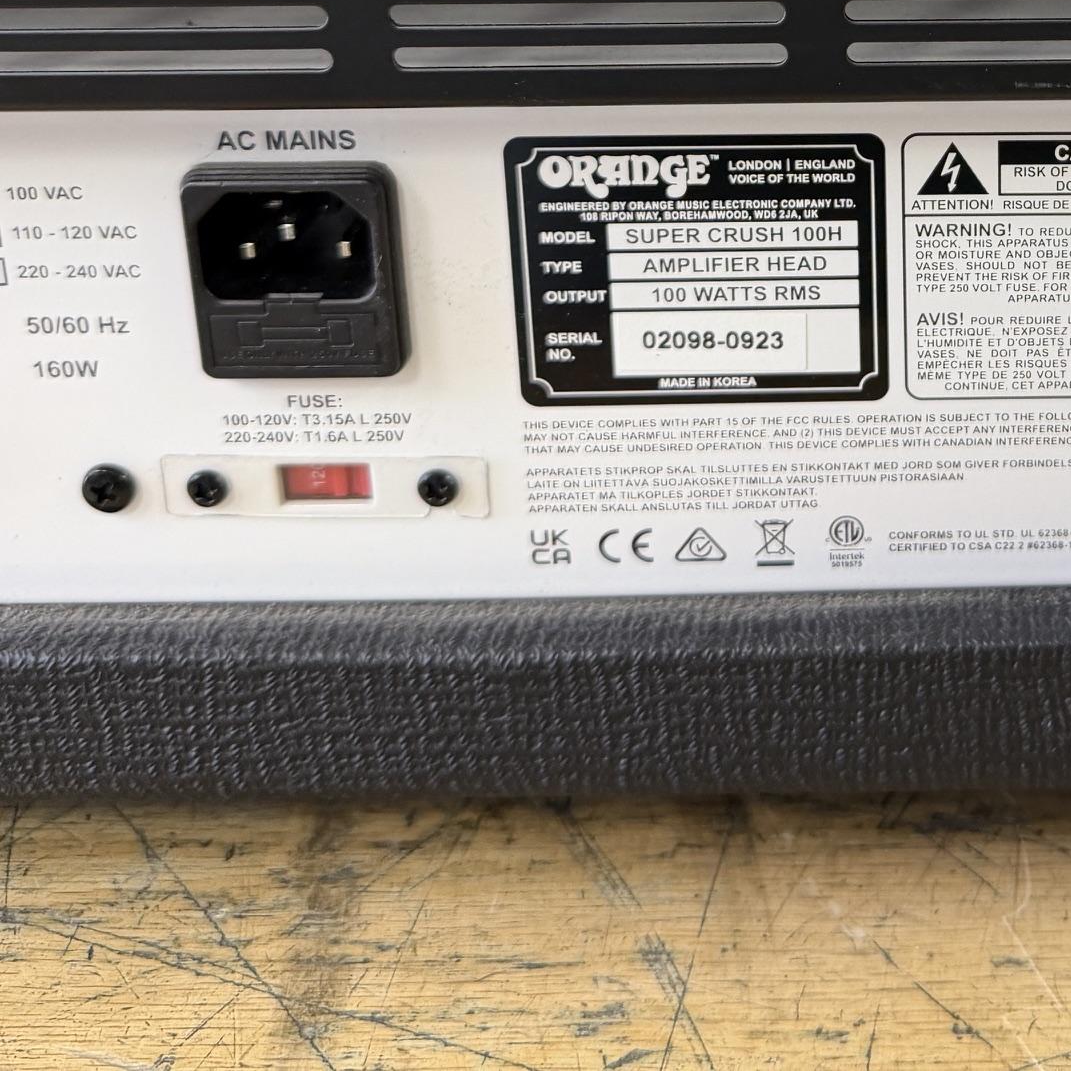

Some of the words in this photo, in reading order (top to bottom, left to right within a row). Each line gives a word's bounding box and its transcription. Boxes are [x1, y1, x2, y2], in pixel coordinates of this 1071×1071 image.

[216, 130, 255, 150] AC
[264, 129, 356, 150] MAINS
[728, 159, 782, 171] LONDON
[794, 158, 855, 170] ENGLAND
[1013, 166, 1046, 177] RISK
[1050, 165, 1068, 177] OF
[537, 154, 711, 199] ORANGE
[728, 173, 765, 184] VOICE
[766, 173, 784, 184] OF
[785, 173, 810, 183] THE
[811, 172, 855, 183] WORLD
[6, 186, 37, 200] 100
[43, 185, 82, 200] VAC
[538, 201, 610, 212] ENGINEERED
[610, 201, 626, 211] BY
[627, 200, 674, 211] ORANGE
[675, 200, 710, 210] MUSIC
[711, 199, 778, 211] ELECTRONIC
[780, 199, 831, 210] COMPANY
[833, 198, 856, 208] LTD.
[911, 199, 993, 210] ATTENTION!
[1003, 199, 1049, 209] RISQUE
[1053, 199, 1069, 209] DE
[579, 211, 598, 222] 108
[598, 211, 633, 221] RIPON
[634, 210, 661, 221] WAY,
[662, 209, 751, 221] BOREHAMWOOD,
[753, 209, 777, 219] WD6
[778, 209, 801, 220] 2JA,
[803, 208, 818, 219] UK
[11, 225, 42, 239] 110
[60, 225, 92, 239] 120
[97, 225, 137, 239] VAC
[625, 227, 700, 244] SUPER
[707, 226, 783, 242] CRUSH
[792, 225, 841, 241] 100H
[915, 222, 1011, 237] WARNING!
[1017, 227, 1034, 236] TO
[538, 230, 596, 244] MODEL
[966, 238, 992, 248] THIS
[997, 238, 1068, 247] APPARATUS
[915, 250, 932, 259] OR
[937, 249, 1001, 259] MOISTURE
[1005, 249, 1031, 259] AND
[16, 264, 48, 278] 220
[65, 264, 97, 278] 240
[102, 264, 141, 278] VAC
[540, 260, 582, 274] TYPE
[642, 256, 759, 273] AMPLIFIER
[767, 255, 827, 271] HEAD
[966, 260, 1015, 270] SHOULD
[1023, 260, 1047, 269] NOT
[1056, 260, 1071, 269] BE
[916, 272, 971, 282] PREVENT
[974, 272, 997, 281] THE
[1001, 271, 1028, 281] RISK
[1032, 271, 1048, 280] OF
[542, 289, 607, 304] OUTPUT
[652, 287, 686, 302] 100
[693, 285, 767, 302] WATTS
[774, 285, 821, 300] RMS
[26, 316, 89, 334] 50/60
[98, 316, 130, 333] Hz
[916, 311, 963, 326] AVIS!
[545, 331, 602, 346] SERIAL
[642, 330, 783, 349] 02098-0923
[546, 347, 575, 362] NO.
[33, 360, 98, 378] 160W
[658, 377, 695, 388] MADE
[697, 376, 710, 387] IN
[712, 376, 757, 387] KOREA
[286, 394, 342, 408] FUSE:
[222, 413, 296, 426] 100-120V:
[301, 413, 356, 425] T3.15A
[359, 413, 369, 425] L
[373, 412, 412, 425] 250V
[524, 420, 548, 429] THIS
[552, 419, 592, 429] DEVICE
[597, 418, 656, 428] COMPLIES
[660, 418, 688, 427] WITH
[692, 417, 720, 426] PART
[726, 417, 738, 425] 15
[741, 417, 756, 425] OF
[761, 416, 782, 425] THE
[786, 416, 809, 424] FCC
[857, 414, 922, 423] OPERATION
[939, 413, 990, 422] SUBJECT
[224, 430, 298, 443] 220-240V:
[303, 430, 348, 442] T1.6A
[352, 430, 362, 442] L
[366, 430, 404, 442] 250V
[530, 529, 569, 546] UK
[888, 530, 953, 539] CONFORMS
[957, 529, 971, 538] TO
[974, 529, 989, 538] UL
[1020, 529, 1034, 538] UL
[598, 528, 655, 563] CE
[888, 542, 947, 552] CERTIFIED
[950, 542, 965, 551] TO
[967, 541, 993, 550] CSA
[532, 548, 571, 564] CA
[829, 551, 864, 561] Intertek
